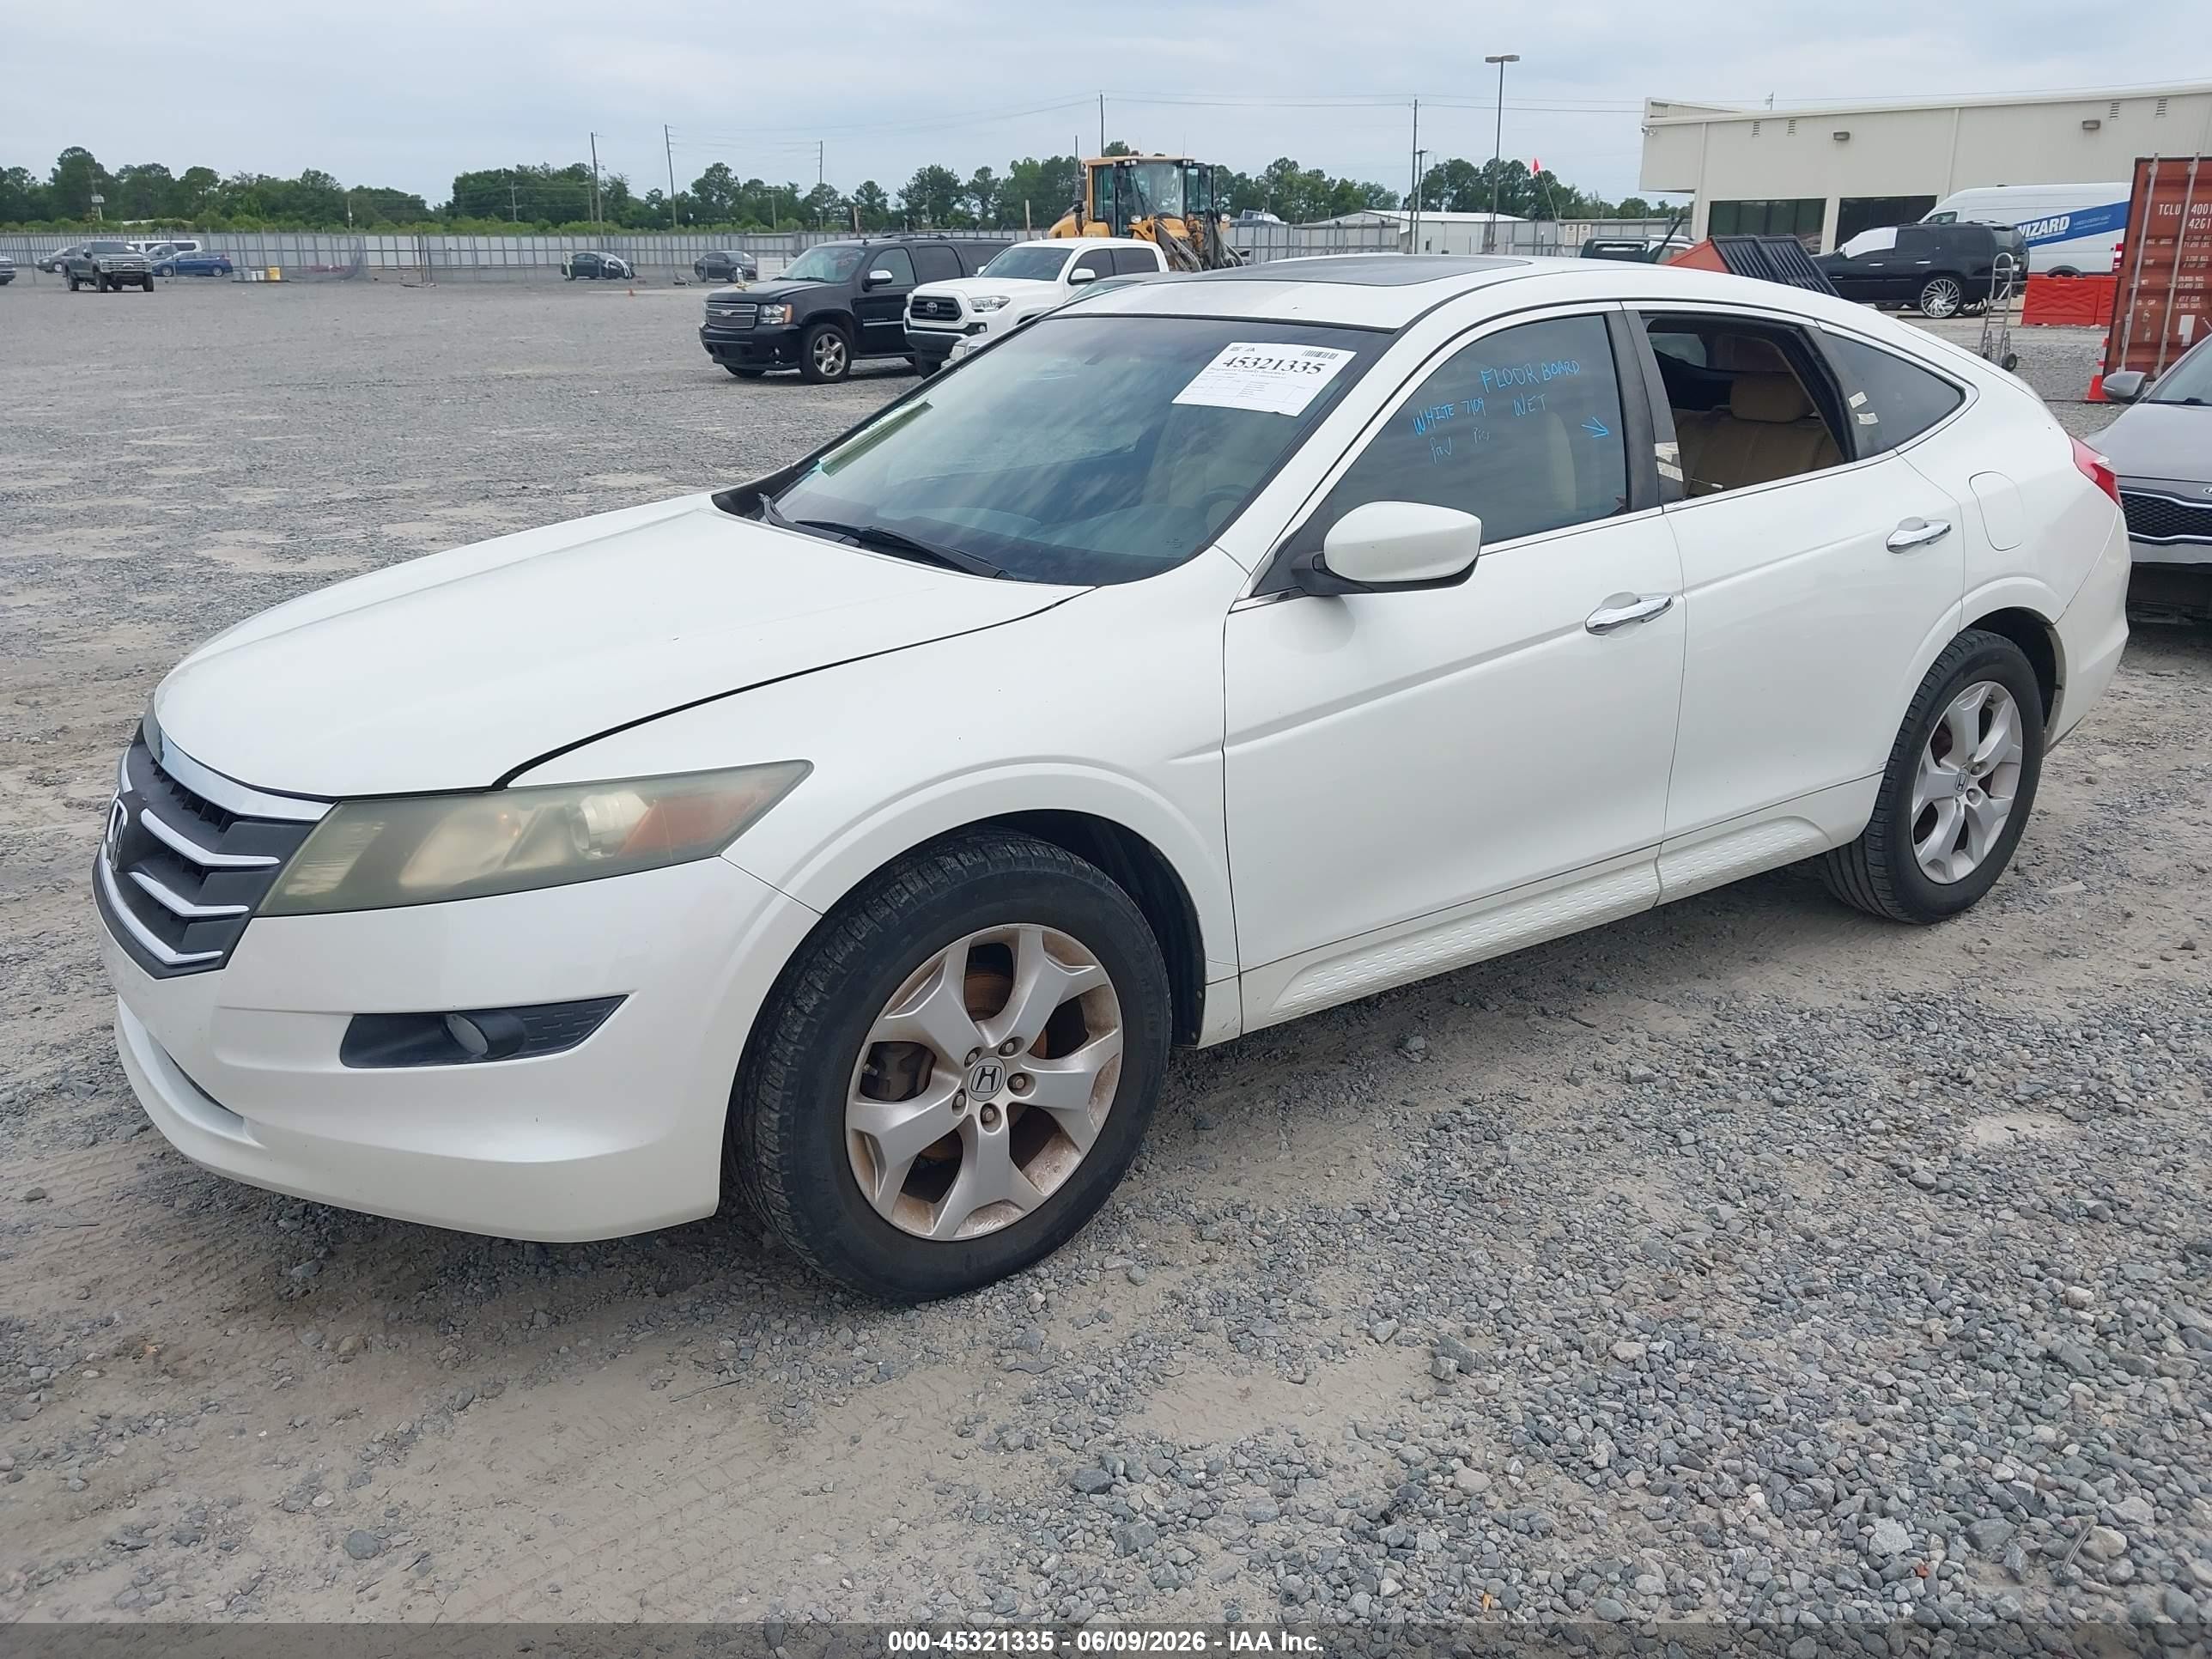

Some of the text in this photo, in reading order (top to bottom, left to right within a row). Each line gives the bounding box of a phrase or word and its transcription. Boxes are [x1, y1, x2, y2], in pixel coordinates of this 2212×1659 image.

[2159, 204, 2181, 216] TCLU
[2188, 218, 2211, 229] 42G1
[1223, 356, 1326, 374] 45321335
[1480, 360, 1580, 393] FLOOR BOARD
[1513, 392, 1547, 416] WET
[1413, 403, 1455, 435] WHITE
